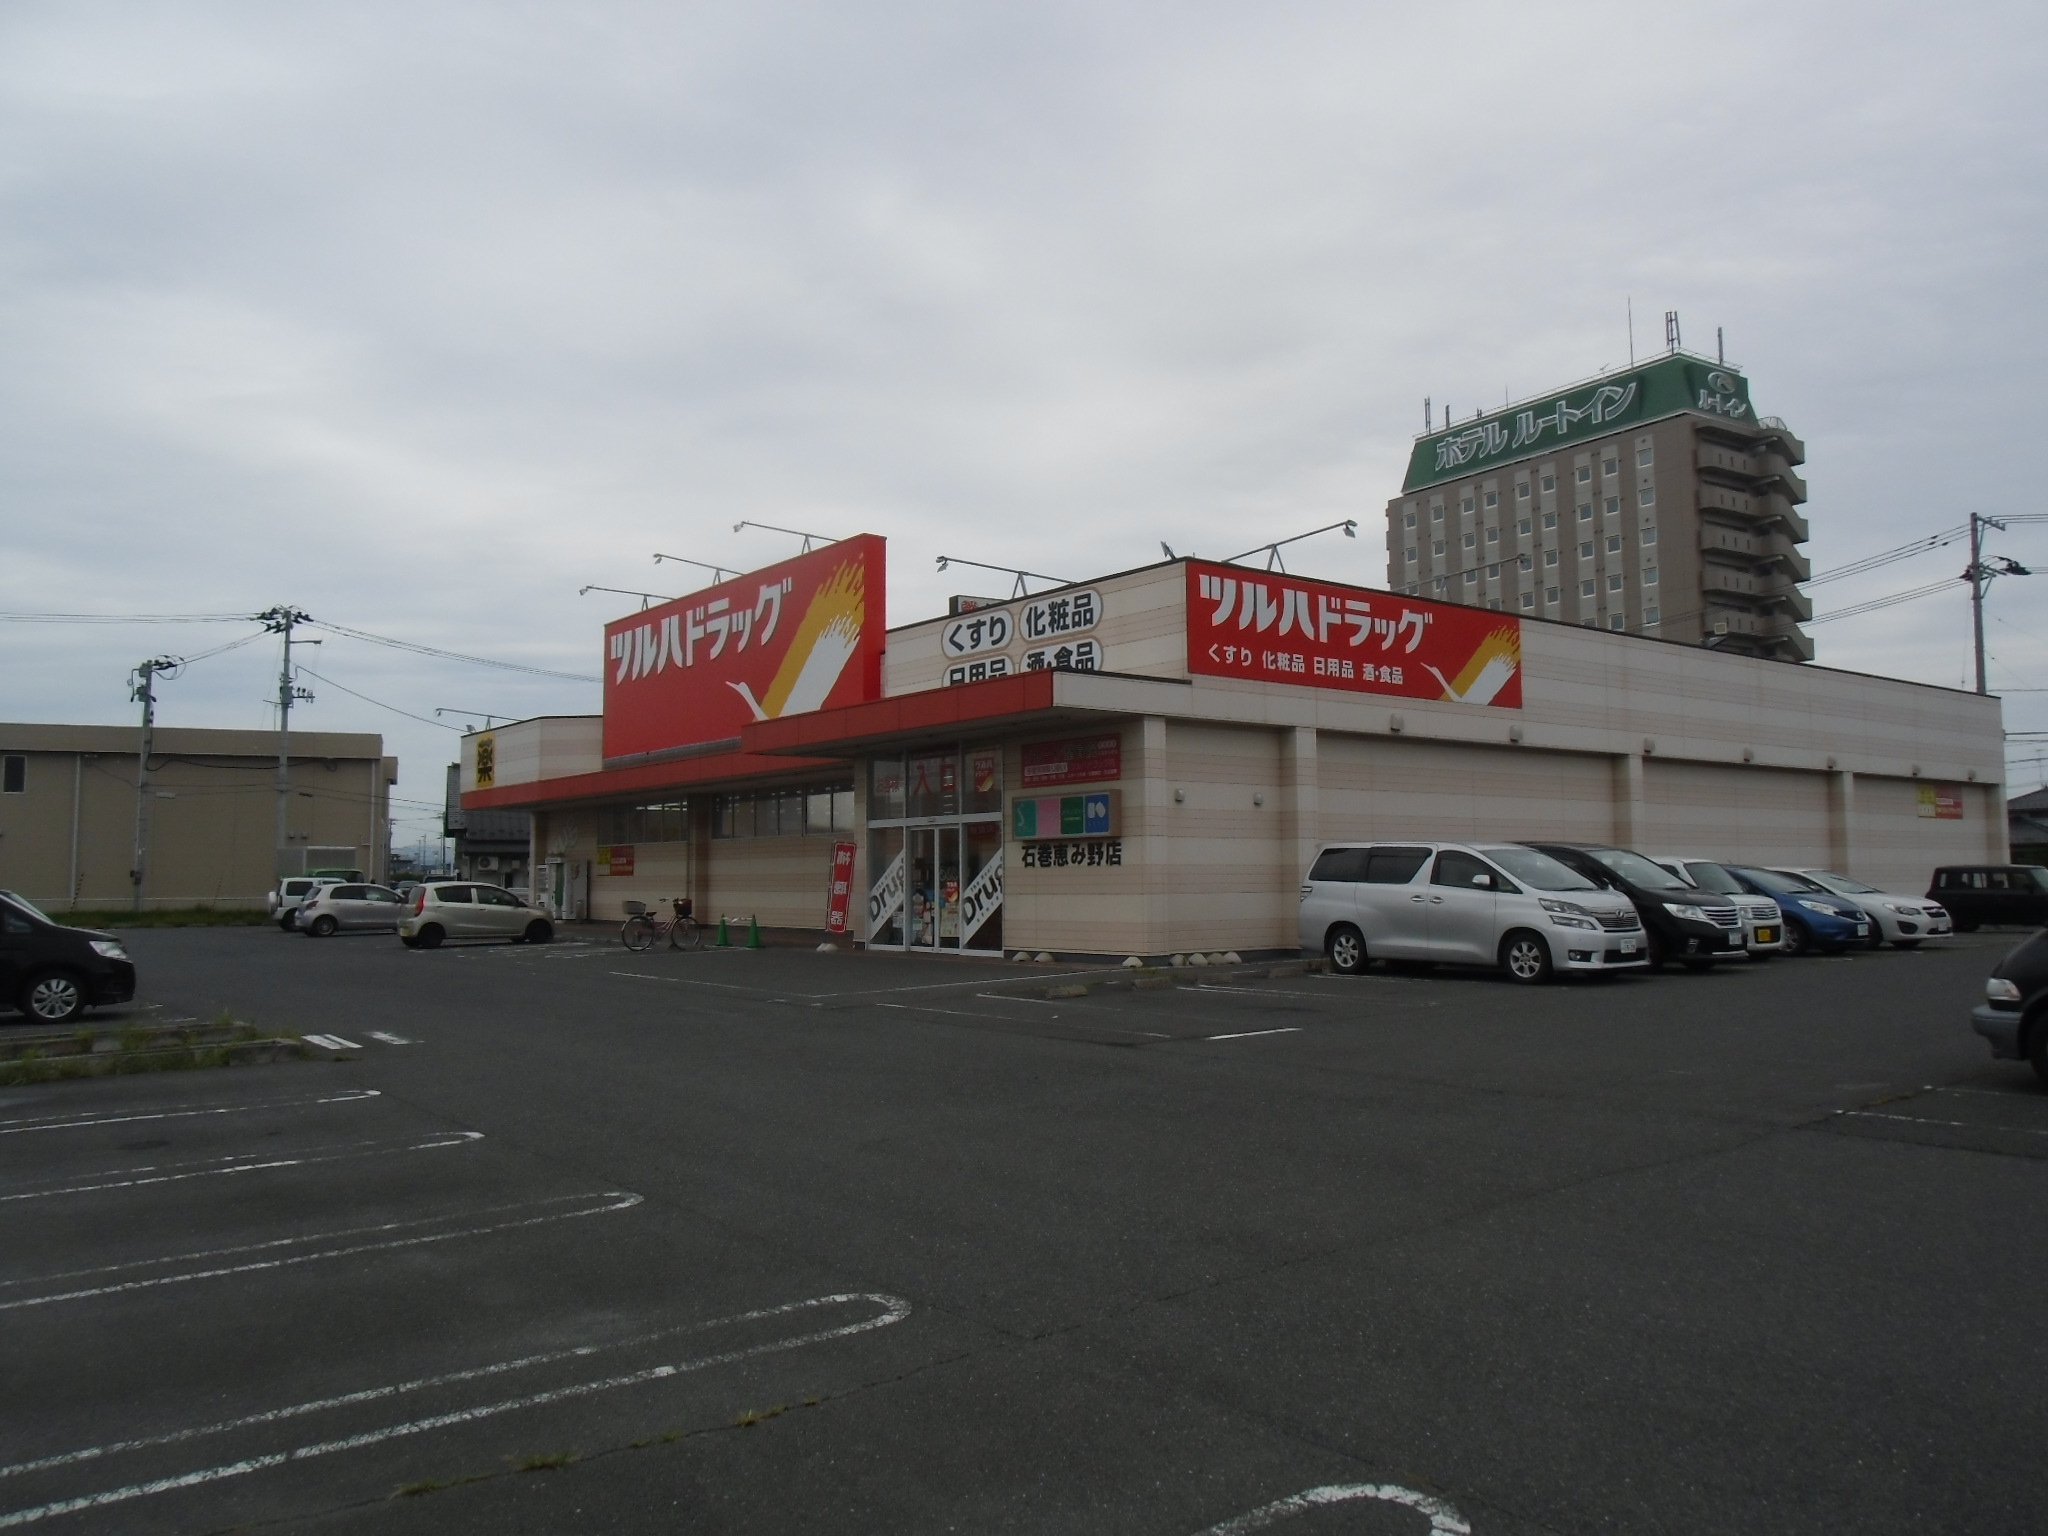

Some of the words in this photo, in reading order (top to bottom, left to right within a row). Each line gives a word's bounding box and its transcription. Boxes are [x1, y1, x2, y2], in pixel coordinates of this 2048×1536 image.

[1435, 421, 1508, 471] ホテル
[1512, 382, 1637, 448] ルートイン
[611, 577, 792, 685] ツルハドラッグ
[949, 616, 1006, 652] くすり
[1026, 593, 1093, 638] 化粧品
[1199, 574, 1433, 654] ツルハドラッグ
[1208, 643, 1252, 667] くすり
[1262, 650, 1305, 674] 化粧品
[1313, 656, 1354, 679] 日用品
[1021, 842, 1122, 868] 石巻恵み野店
